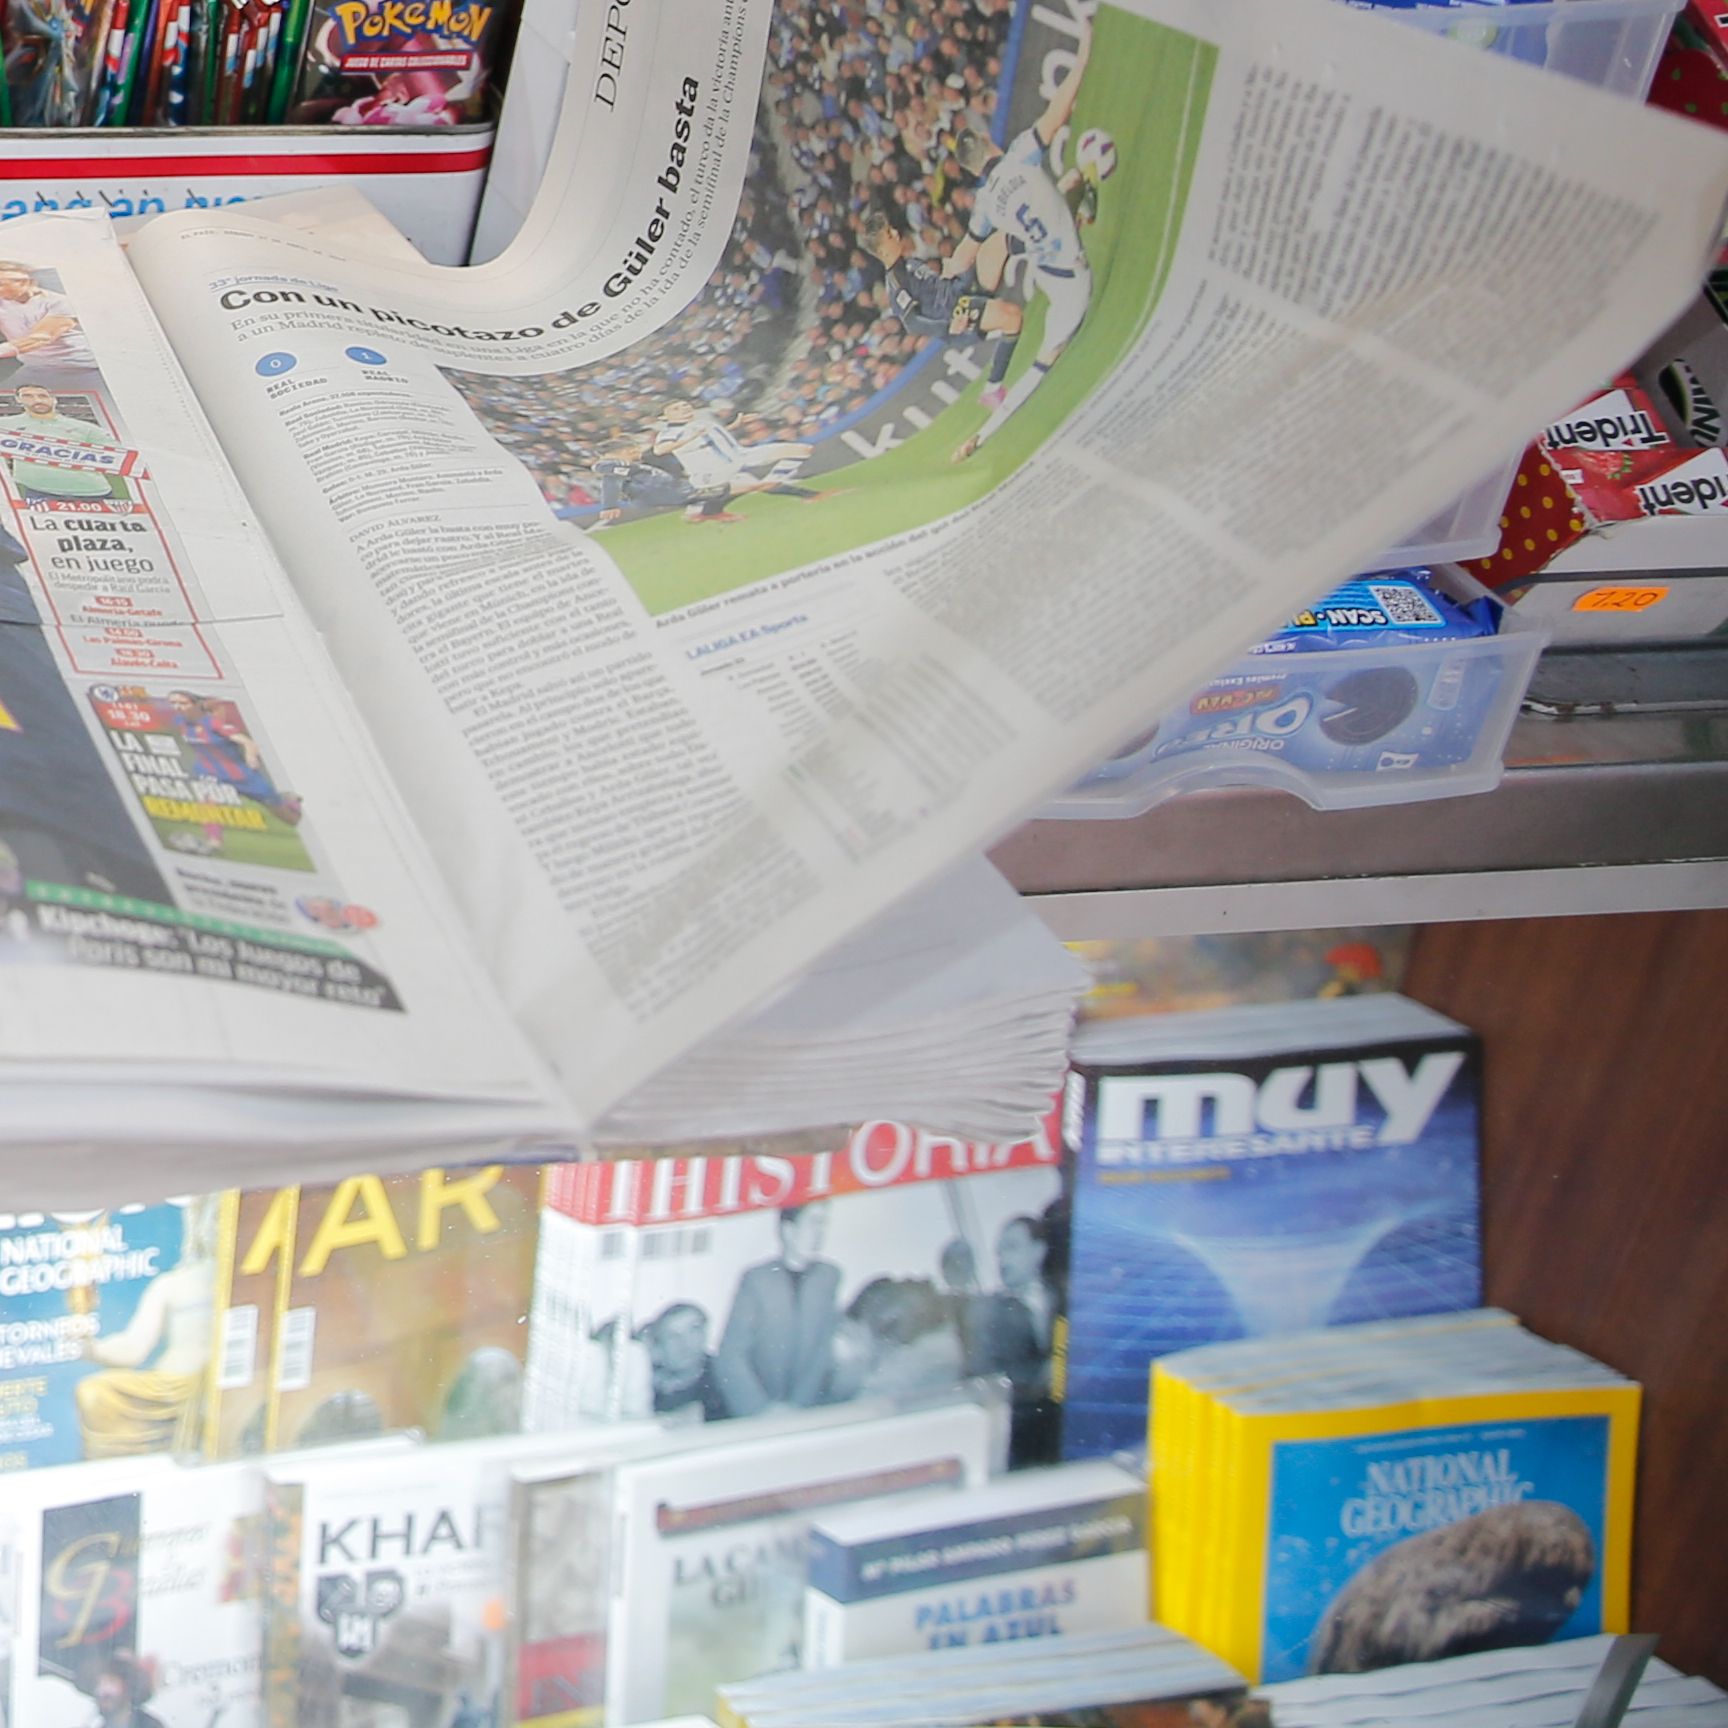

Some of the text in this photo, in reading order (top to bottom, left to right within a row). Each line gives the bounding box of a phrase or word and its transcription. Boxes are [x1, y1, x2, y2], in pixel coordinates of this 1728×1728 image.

[344, 56, 370, 68] JUEGO
[220, 75, 699, 342] Con un picotazo de Güler basta
[0, 437, 116, 465] GRACIAS
[1545, 411, 1667, 451] Trident
[31, 514, 60, 532] La
[51, 554, 155, 575] en juego
[57, 535, 135, 555] plaza,
[1330, 608, 1387, 626] SCAN
[1096, 1051, 1467, 1148] muy
[1095, 1124, 1377, 1165] INTERESANTE
[1364, 1448, 1513, 1498] NATIONAL
[1339, 1480, 1536, 1537] GEOGRAPHIC
[914, 1579, 1077, 1628] PALABRAS
